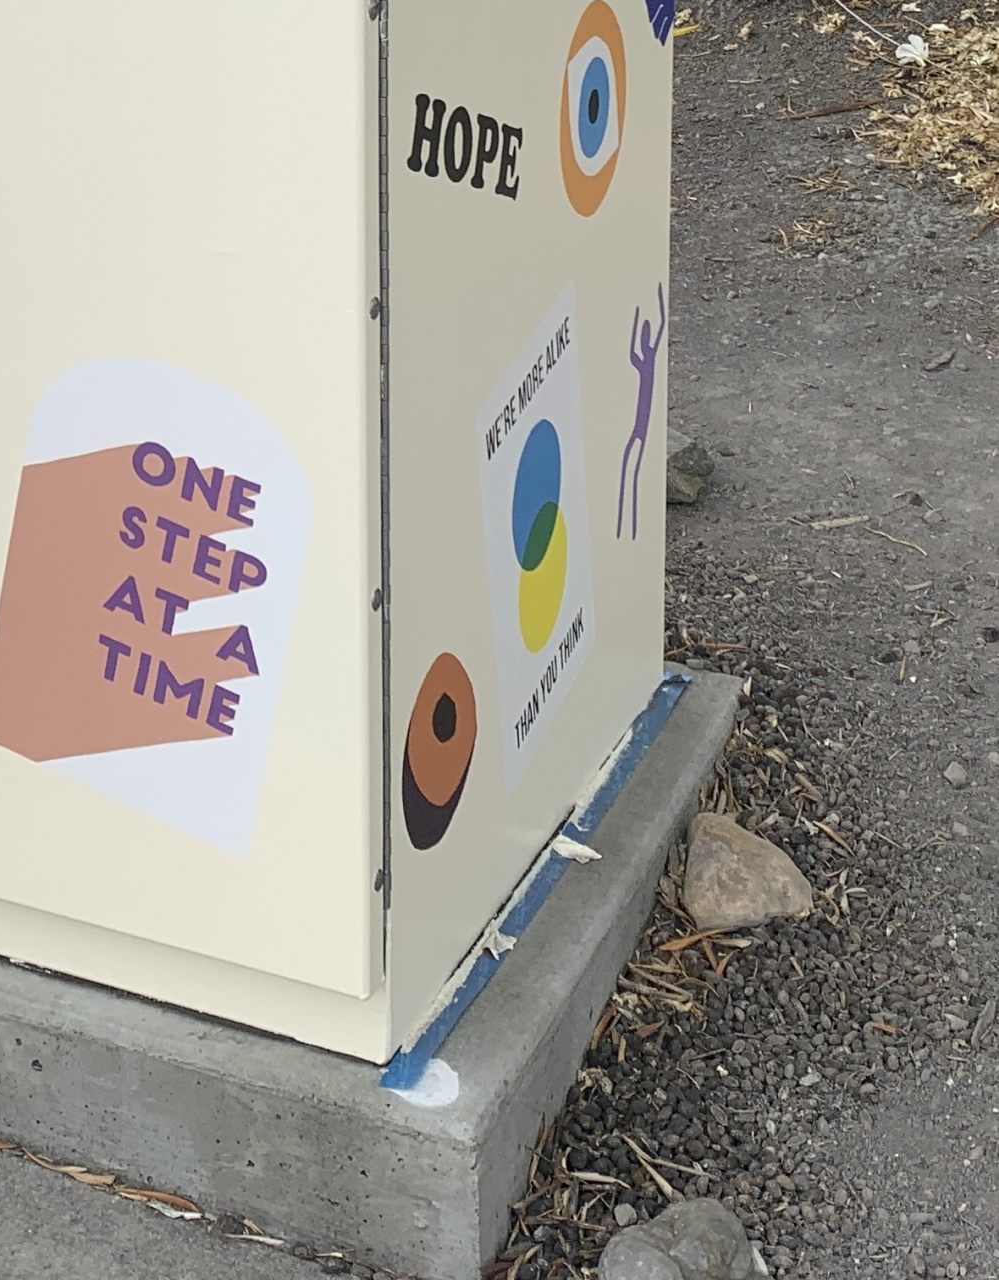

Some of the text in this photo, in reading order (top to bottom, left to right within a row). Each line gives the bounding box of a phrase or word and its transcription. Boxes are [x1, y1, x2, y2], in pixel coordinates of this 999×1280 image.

[407, 94, 523, 201] HOPE
[485, 316, 570, 461] WE'RE MORE ALIKE
[132, 441, 262, 528] ONE
[119, 506, 267, 593] STEP
[103, 575, 260, 676] AT A
[99, 633, 241, 737] TIME
[515, 607, 584, 749] THAN YOU THINK
